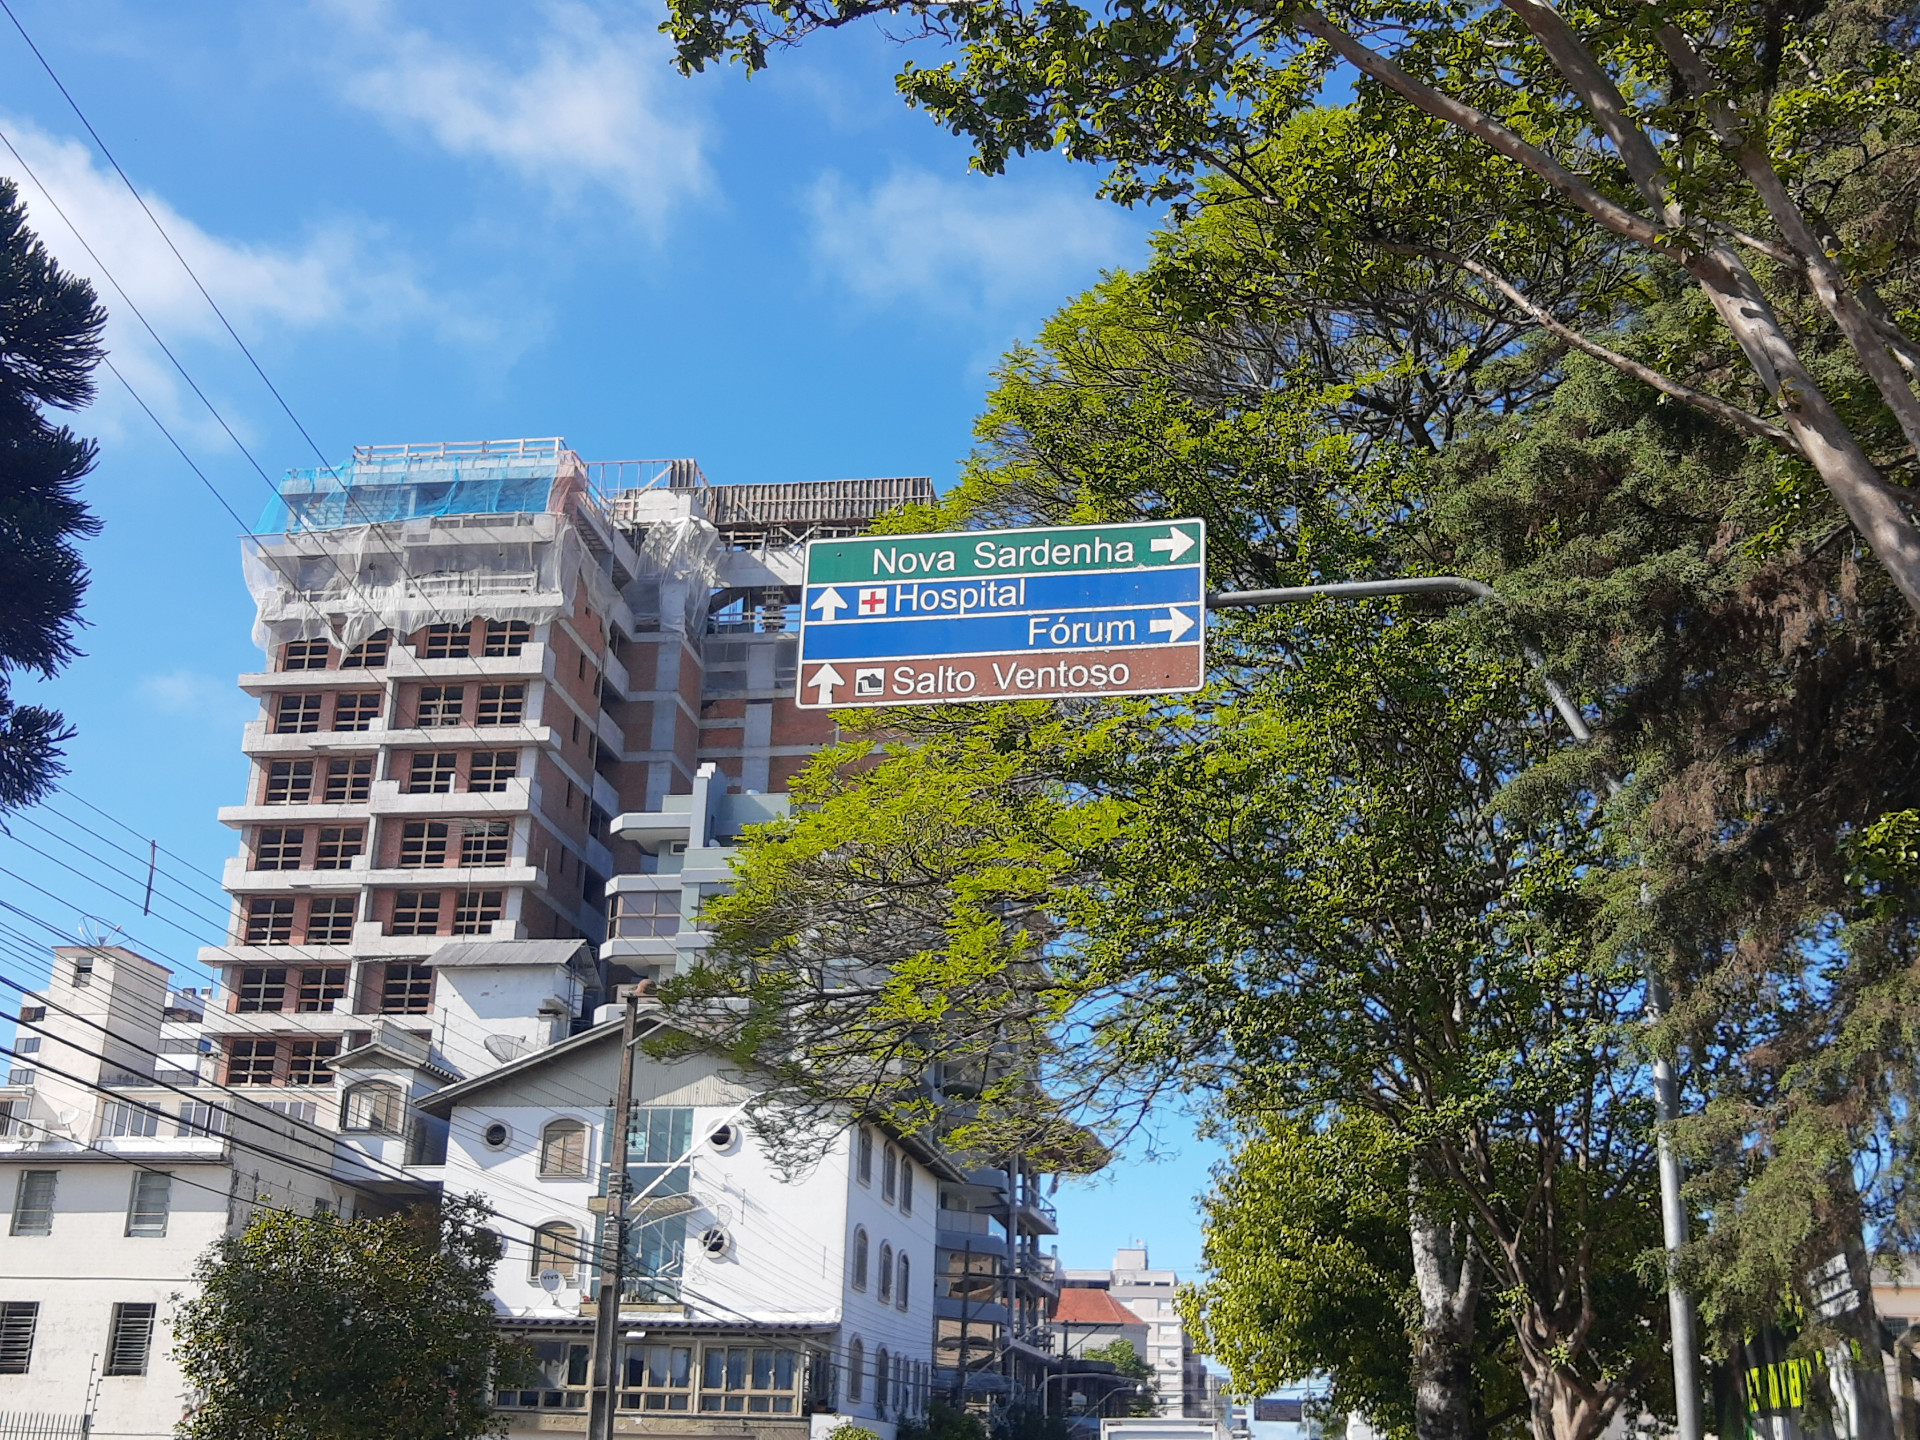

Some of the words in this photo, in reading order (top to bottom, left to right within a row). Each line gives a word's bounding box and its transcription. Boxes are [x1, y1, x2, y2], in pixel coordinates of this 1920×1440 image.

[873, 547, 956, 575] Nova
[973, 537, 1134, 569] Sardenha
[894, 578, 1026, 614] Hospital
[1028, 616, 1136, 645] Fórum
[892, 666, 976, 695] Salto
[992, 662, 1131, 692] Ventoso
